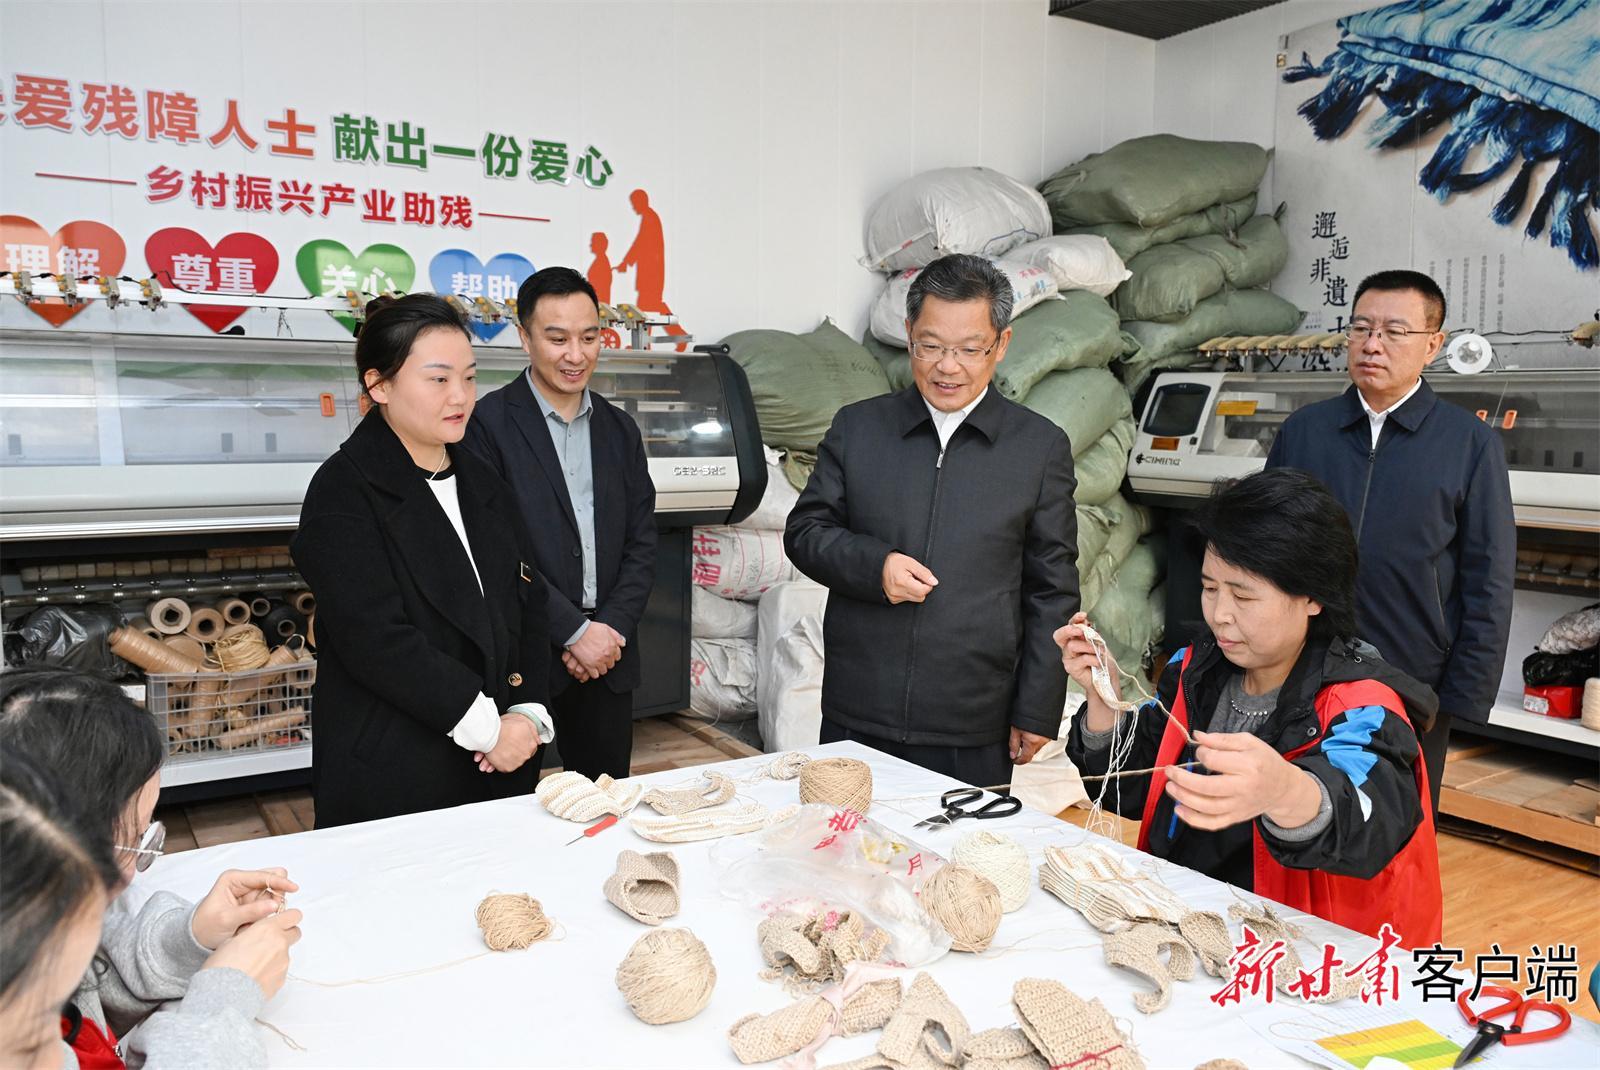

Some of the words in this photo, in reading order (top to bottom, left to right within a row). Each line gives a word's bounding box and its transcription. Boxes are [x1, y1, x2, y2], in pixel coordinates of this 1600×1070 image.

[0, 73, 316, 158] 爱残障人士
[333, 113, 614, 187] 献出一份爱心
[147, 165, 473, 229] 乡村振兴产业助残
[6, 244, 100, 286] 理解
[171, 253, 257, 293] 尊重
[321, 264, 397, 297] 关心
[451, 271, 518, 303] 帮助
